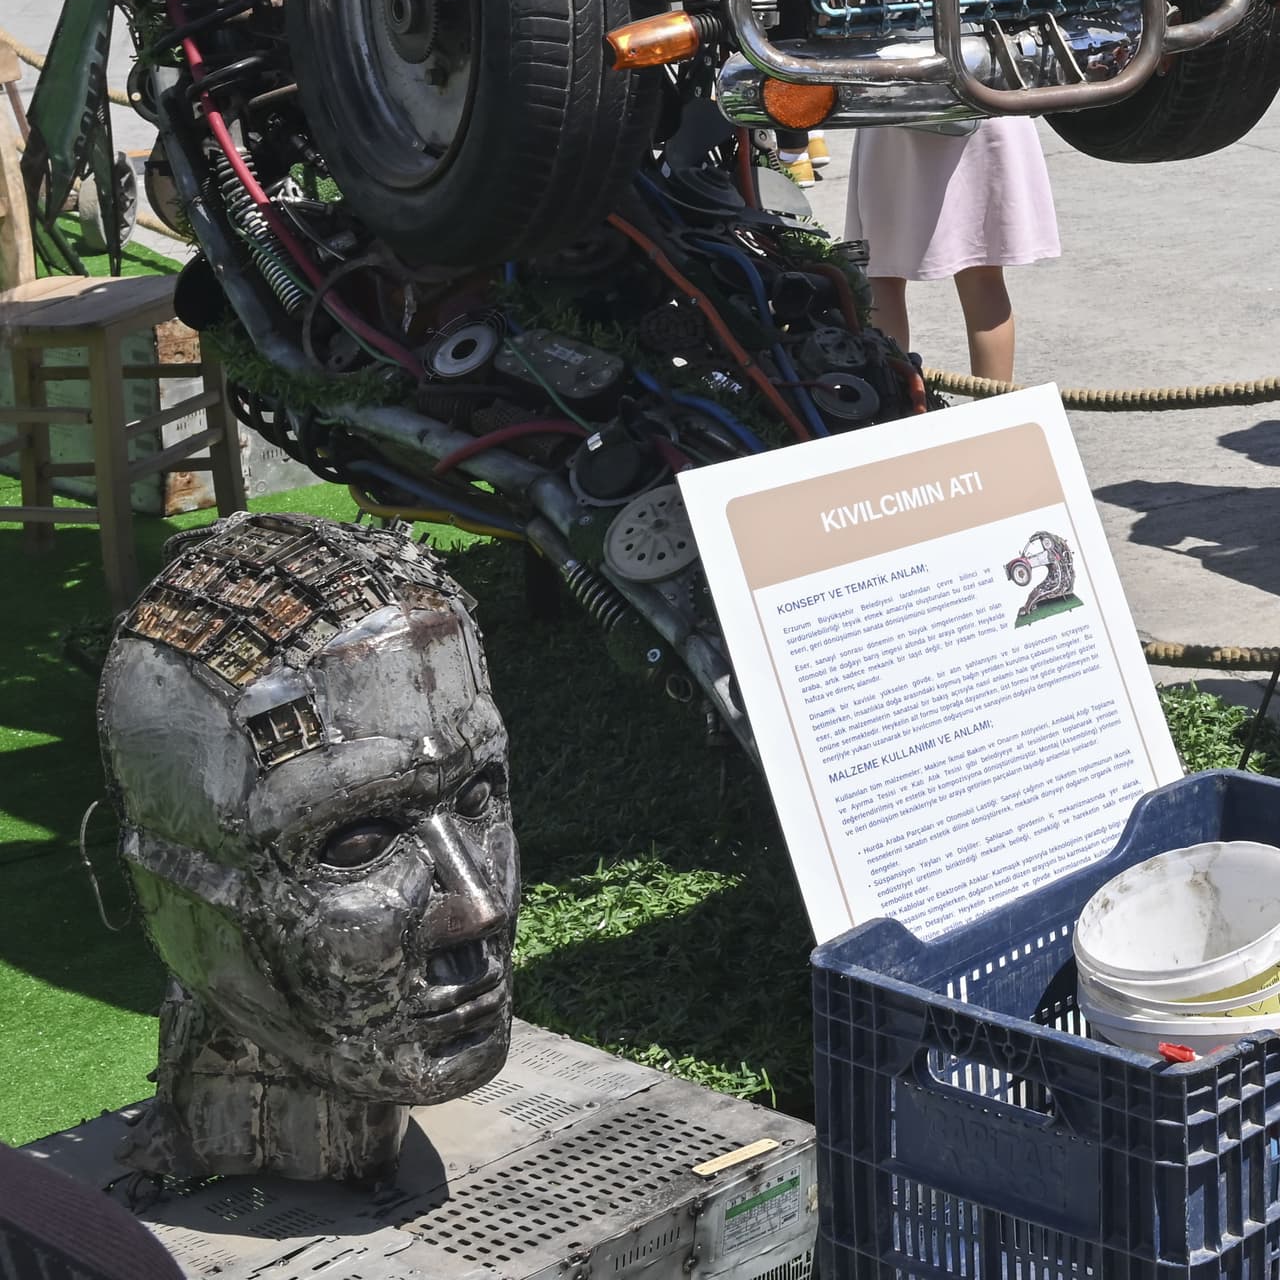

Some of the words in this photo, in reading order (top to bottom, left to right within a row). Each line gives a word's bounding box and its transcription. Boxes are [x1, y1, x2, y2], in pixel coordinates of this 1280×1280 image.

[820, 480, 944, 533] KIVILCIMIN
[949, 471, 983, 498] ATI
[777, 592, 825, 614] KONSEPT
[827, 587, 843, 599] VE
[844, 574, 888, 594] TEMATİK
[890, 563, 928, 581] ANLAM;
[828, 758, 879, 783] MALZEME
[881, 739, 936, 764] KULLANIMI
[937, 733, 952, 744] VE
[954, 720, 993, 739] ANLAMI;
